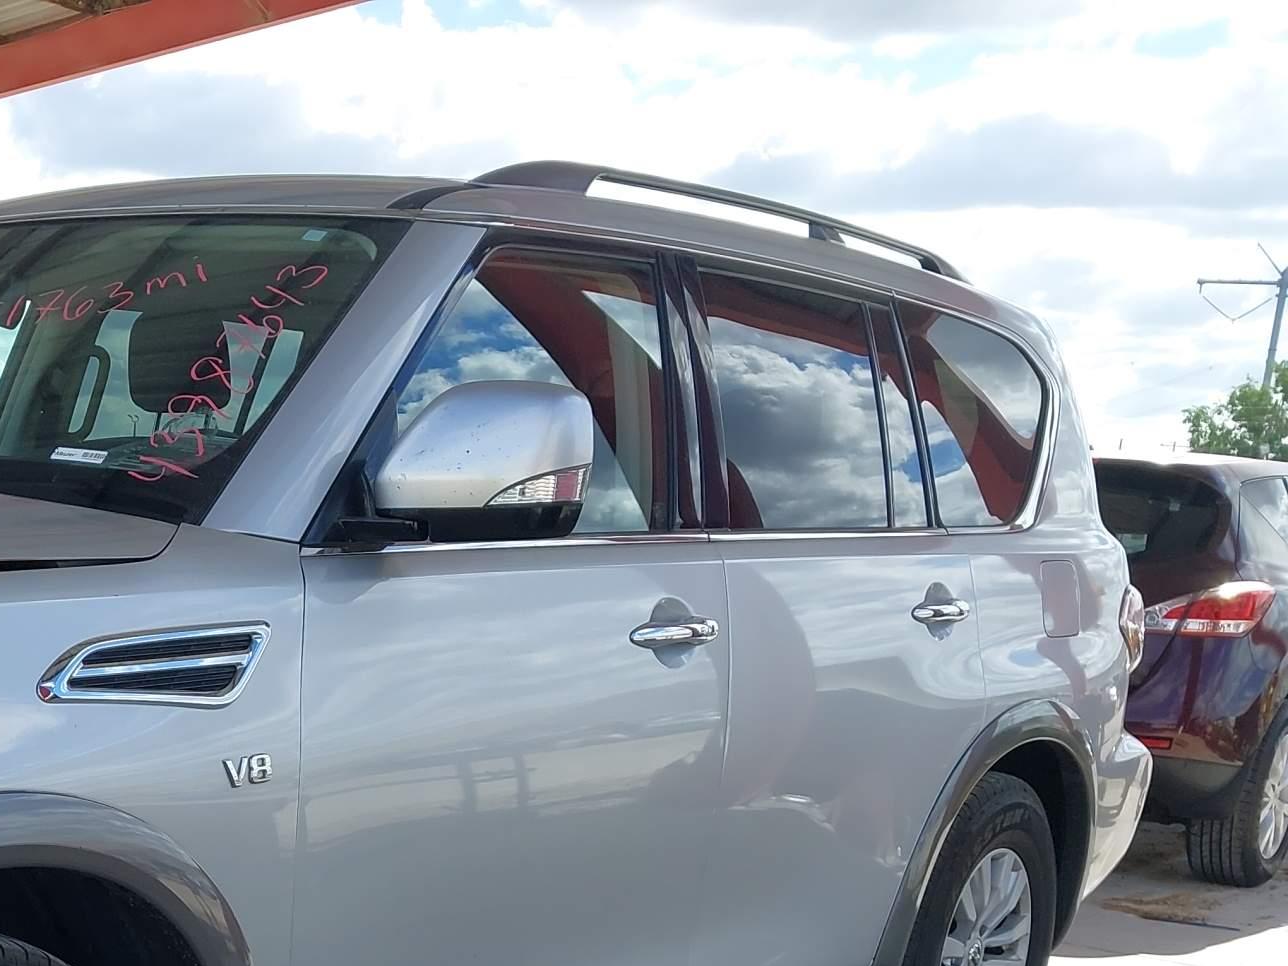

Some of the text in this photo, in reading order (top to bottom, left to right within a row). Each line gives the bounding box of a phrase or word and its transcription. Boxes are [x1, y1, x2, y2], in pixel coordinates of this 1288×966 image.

[145, 257, 208, 295] mi
[127, 265, 328, 481] 43987643
[222, 753, 272, 788] V8
